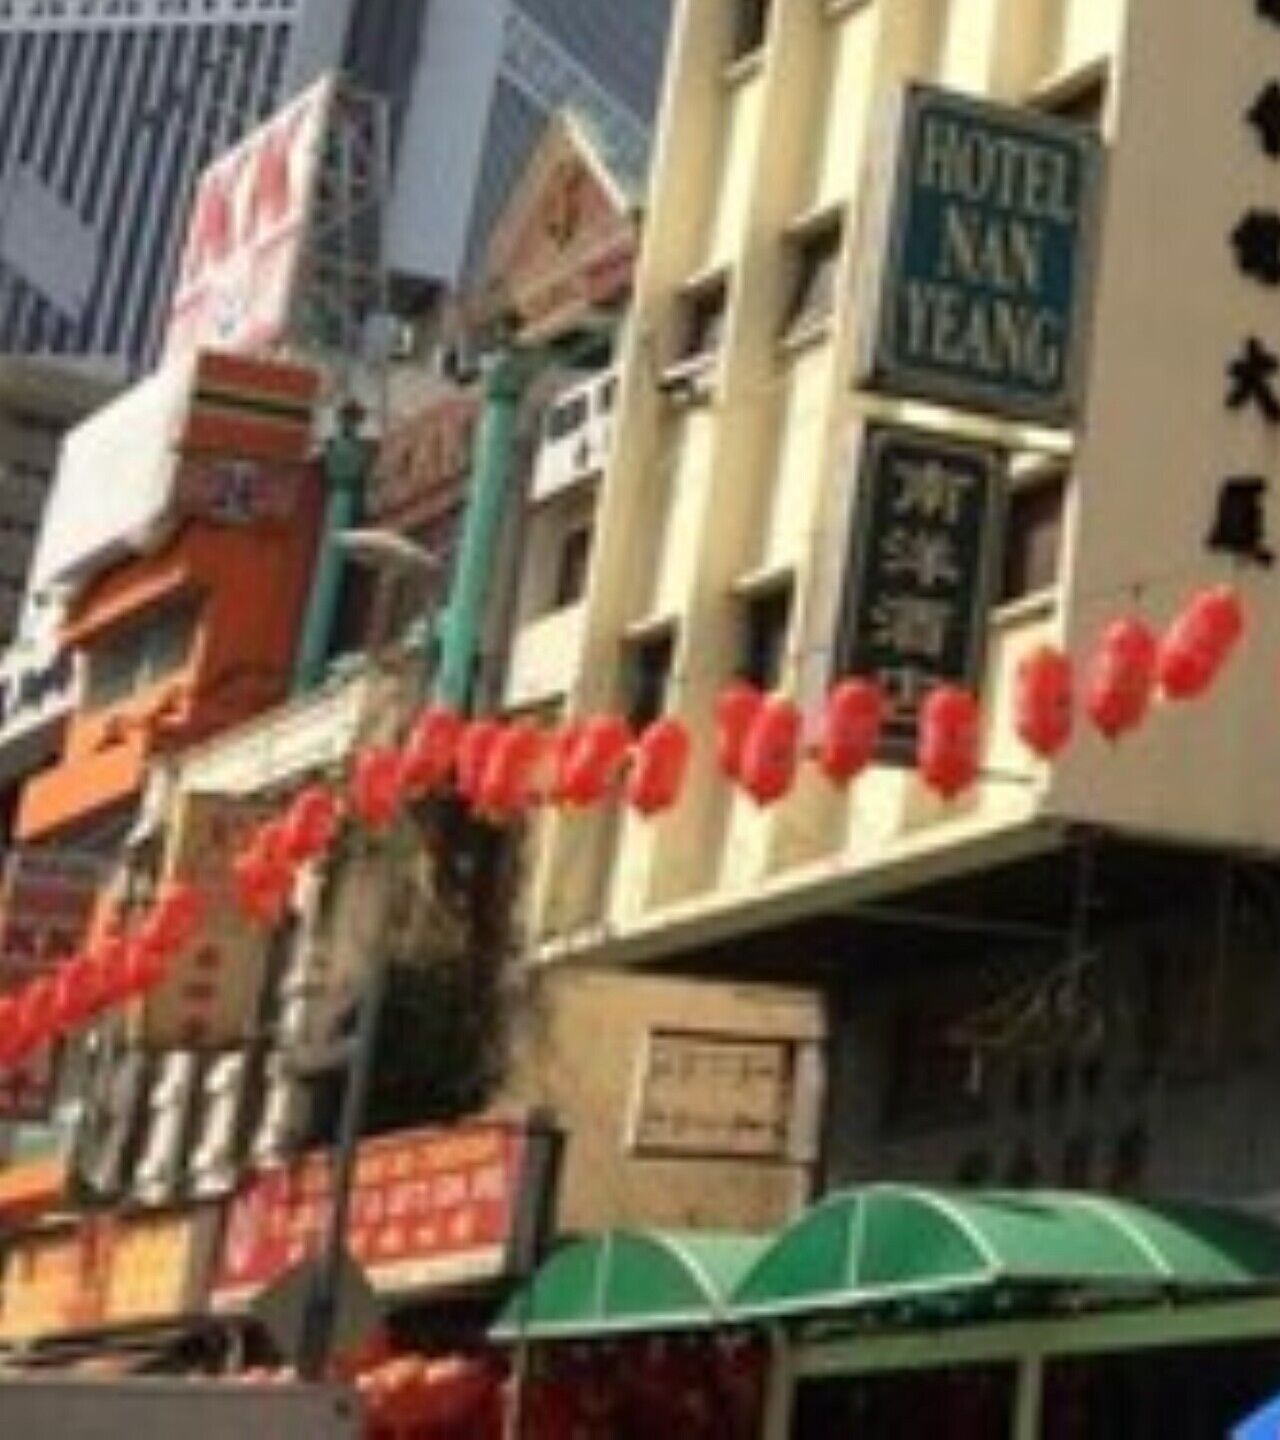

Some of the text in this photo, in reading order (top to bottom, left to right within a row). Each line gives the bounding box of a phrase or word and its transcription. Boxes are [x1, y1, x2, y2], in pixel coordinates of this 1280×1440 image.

[919, 105, 1078, 220] HOTEL
[936, 197, 1044, 298] NAN
[903, 274, 1063, 382] YEANG
